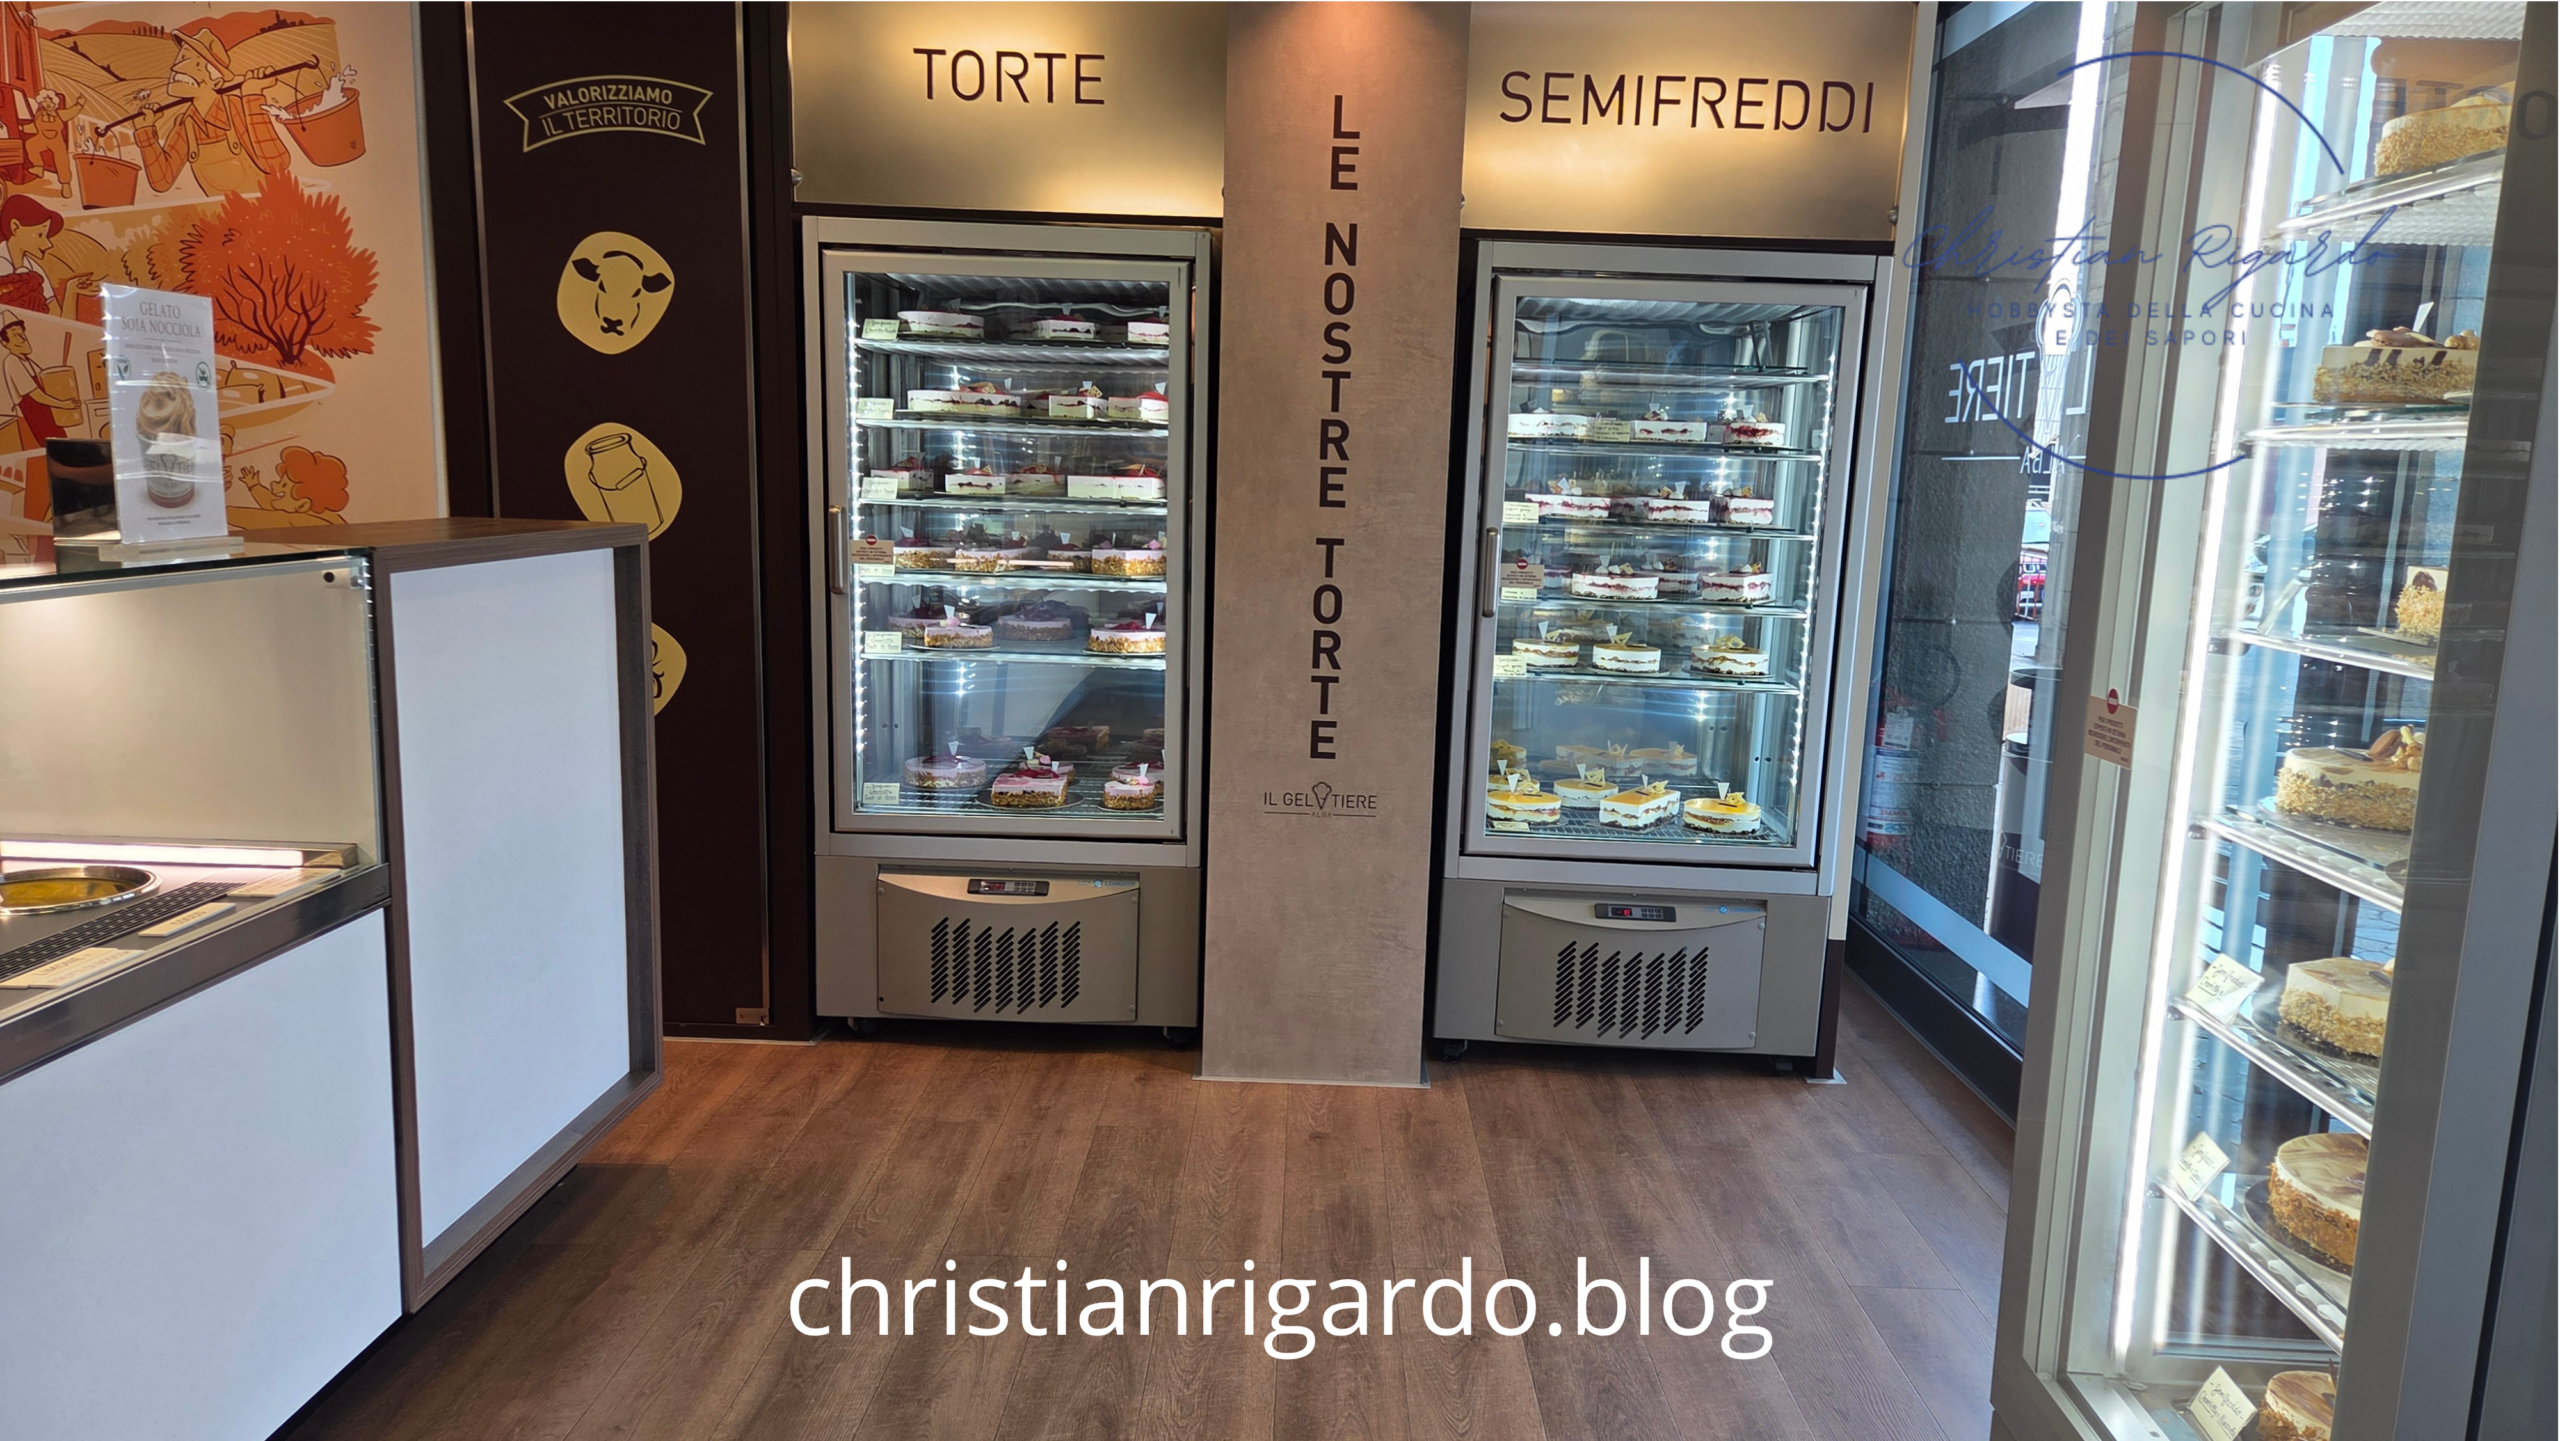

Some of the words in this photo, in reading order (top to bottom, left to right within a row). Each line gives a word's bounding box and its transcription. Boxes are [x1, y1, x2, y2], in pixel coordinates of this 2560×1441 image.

[543, 85, 672, 109] VALORIZZIAMO
[913, 48, 1105, 105] TORTE
[541, 117, 563, 136] IL
[562, 106, 681, 130] TERRITORIO
[1499, 70, 1875, 133] SEMIFREDDI
[1330, 94, 1361, 190] LE
[121, 317, 147, 333] SOIA
[149, 320, 202, 338] NOCCIOLA
[139, 301, 181, 319] GELATO
[1319, 222, 1358, 508] NOSTRE
[1309, 537, 1345, 760] TORTE
[1264, 792, 1278, 806] IL
